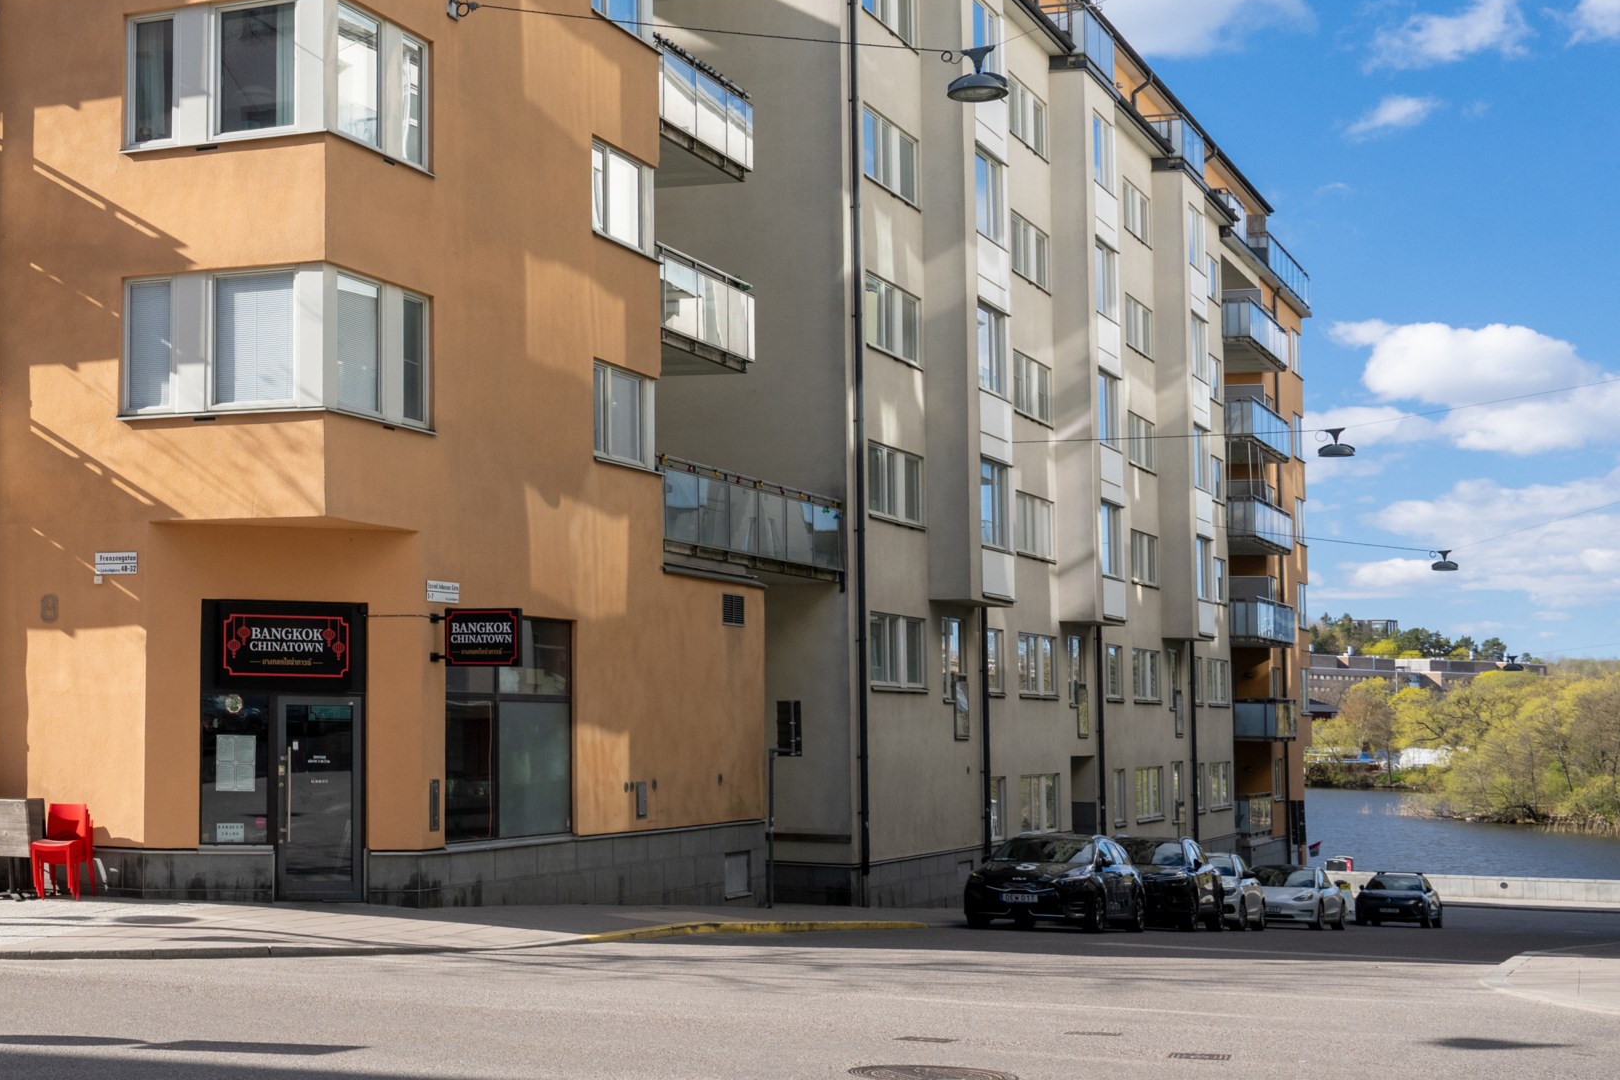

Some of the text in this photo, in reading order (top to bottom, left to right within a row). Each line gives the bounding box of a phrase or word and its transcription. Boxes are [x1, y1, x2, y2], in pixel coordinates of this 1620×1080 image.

[451, 622, 512, 633] BANGKOK
[251, 627, 323, 640] BANGKOK
[450, 634, 512, 644] CHINATOWN
[249, 641, 323, 652] CHINATOWN
